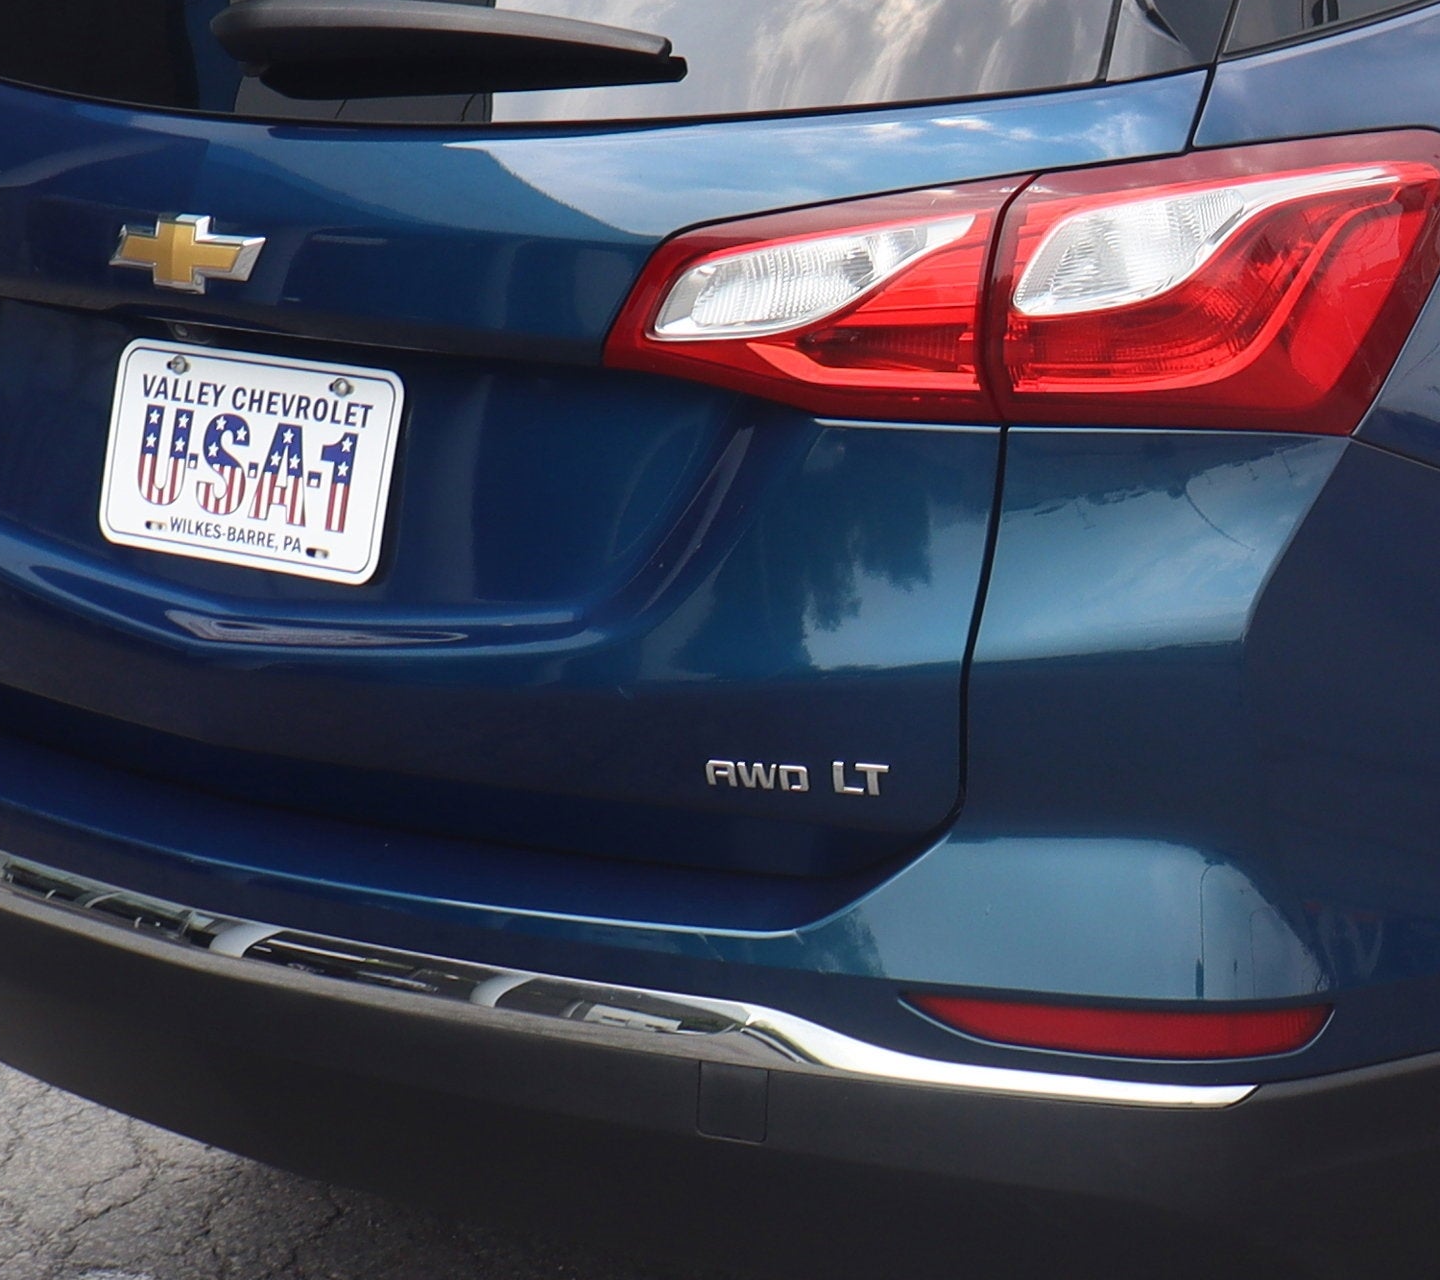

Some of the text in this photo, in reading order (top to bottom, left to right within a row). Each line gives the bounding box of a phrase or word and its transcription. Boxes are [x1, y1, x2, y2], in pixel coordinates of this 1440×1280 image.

[143, 374, 374, 429] VALLEY CHEVROLET
[169, 516, 302, 554] WILKES-BARRE, PA
[705, 759, 890, 797] AWD LT
